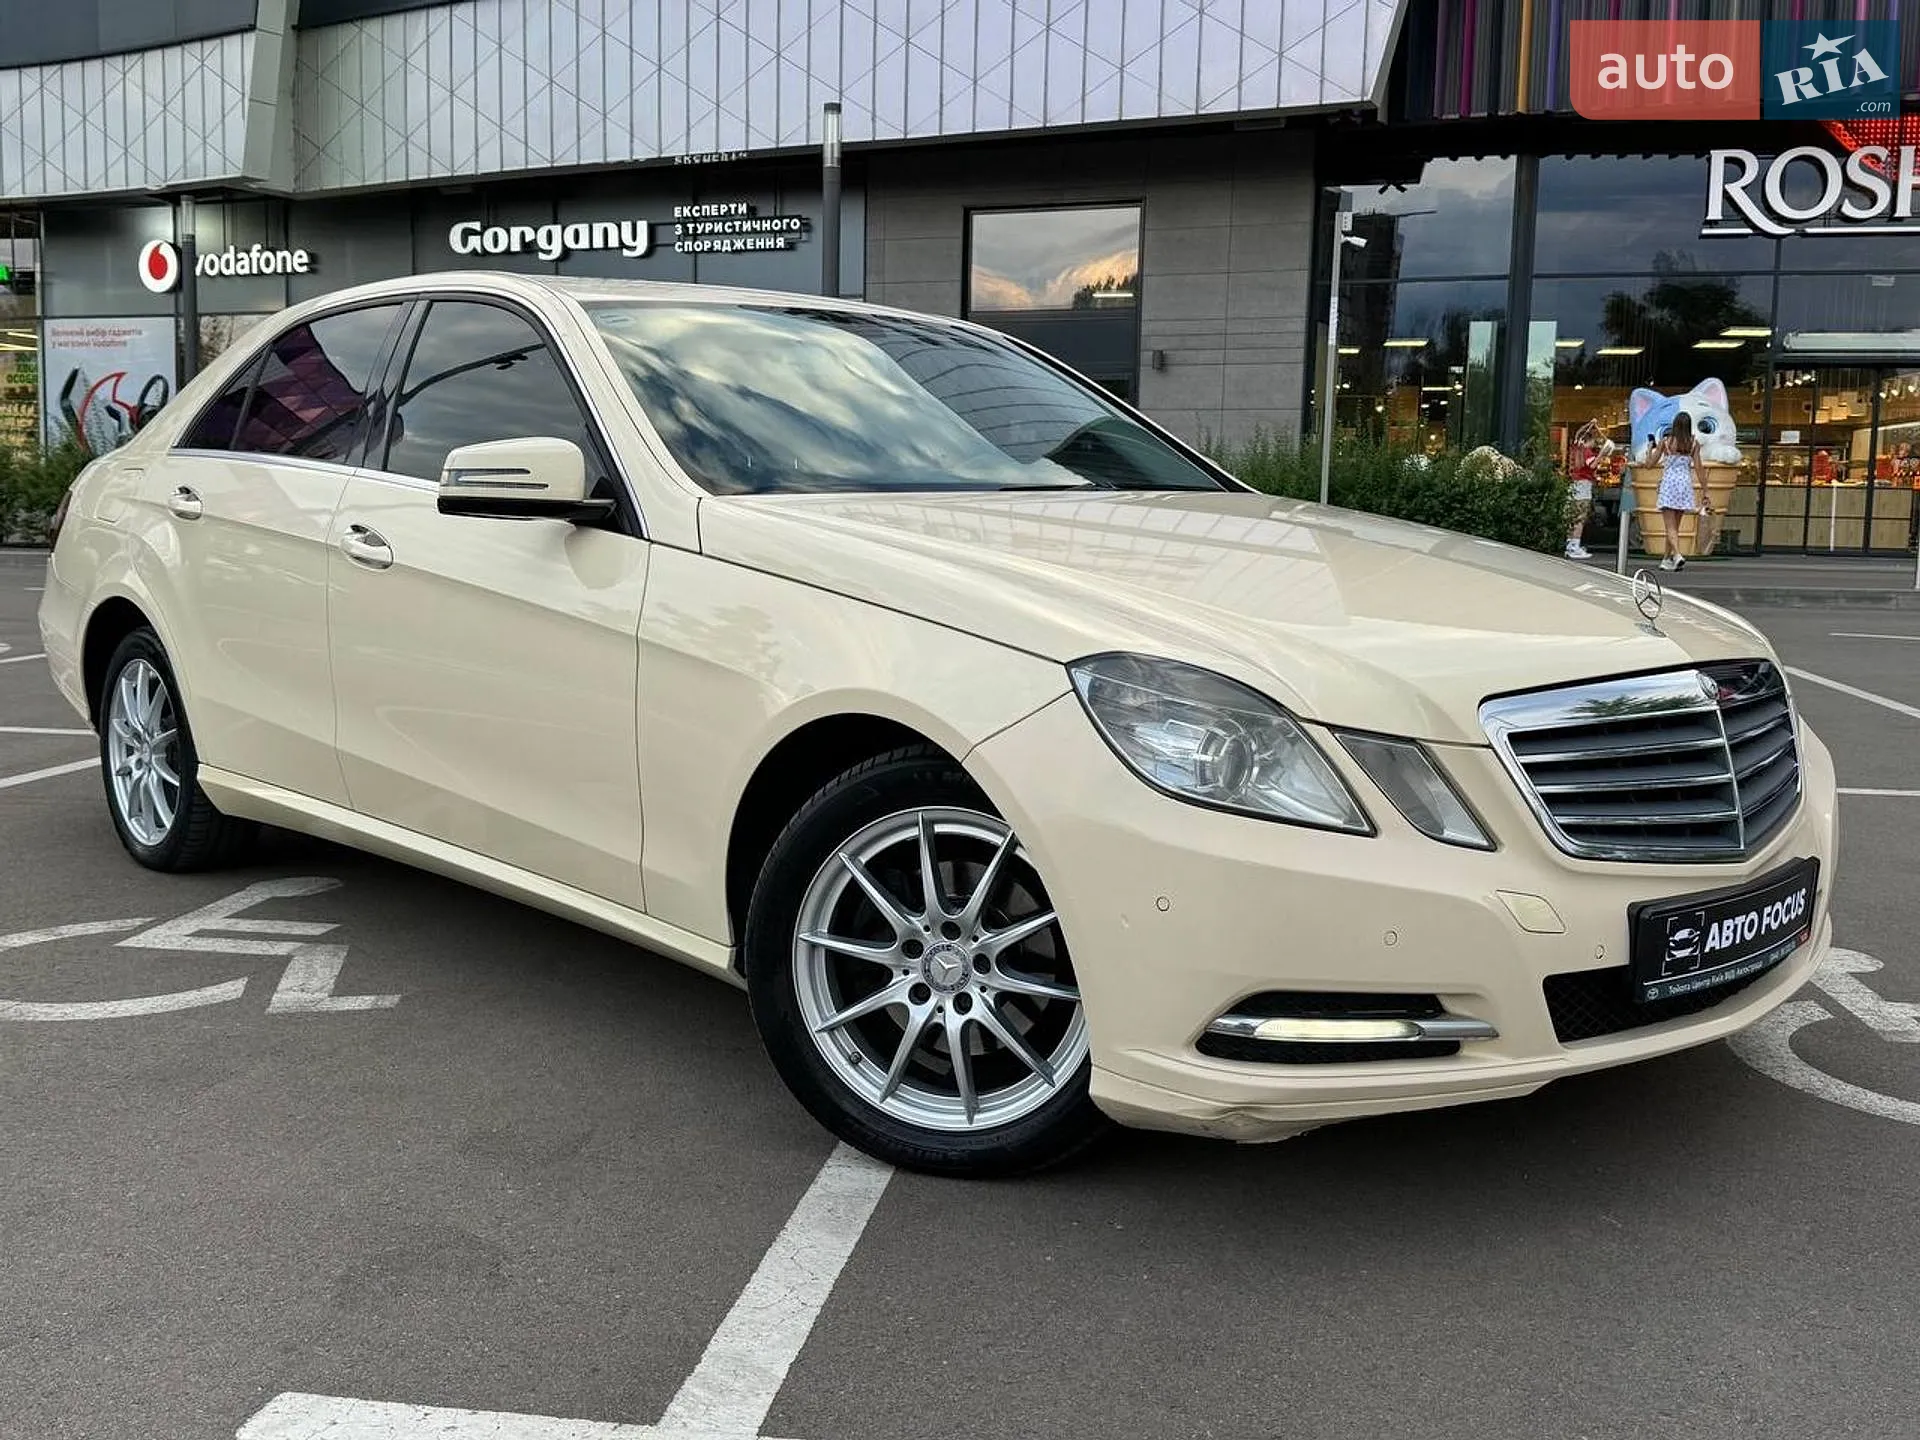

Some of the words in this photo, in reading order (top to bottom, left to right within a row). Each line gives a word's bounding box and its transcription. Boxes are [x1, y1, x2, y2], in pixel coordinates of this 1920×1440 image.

[673, 202, 748, 218] ЕКСПЕРТИ
[686, 218, 801, 235] ТУРИСТИЧНОГО
[449, 219, 649, 261] Gorgany
[674, 237, 785, 253] СПОРЯДЖЕННЯ
[1704, 911, 1757, 953] АВТО
[1761, 888, 1807, 935] FOCUS
